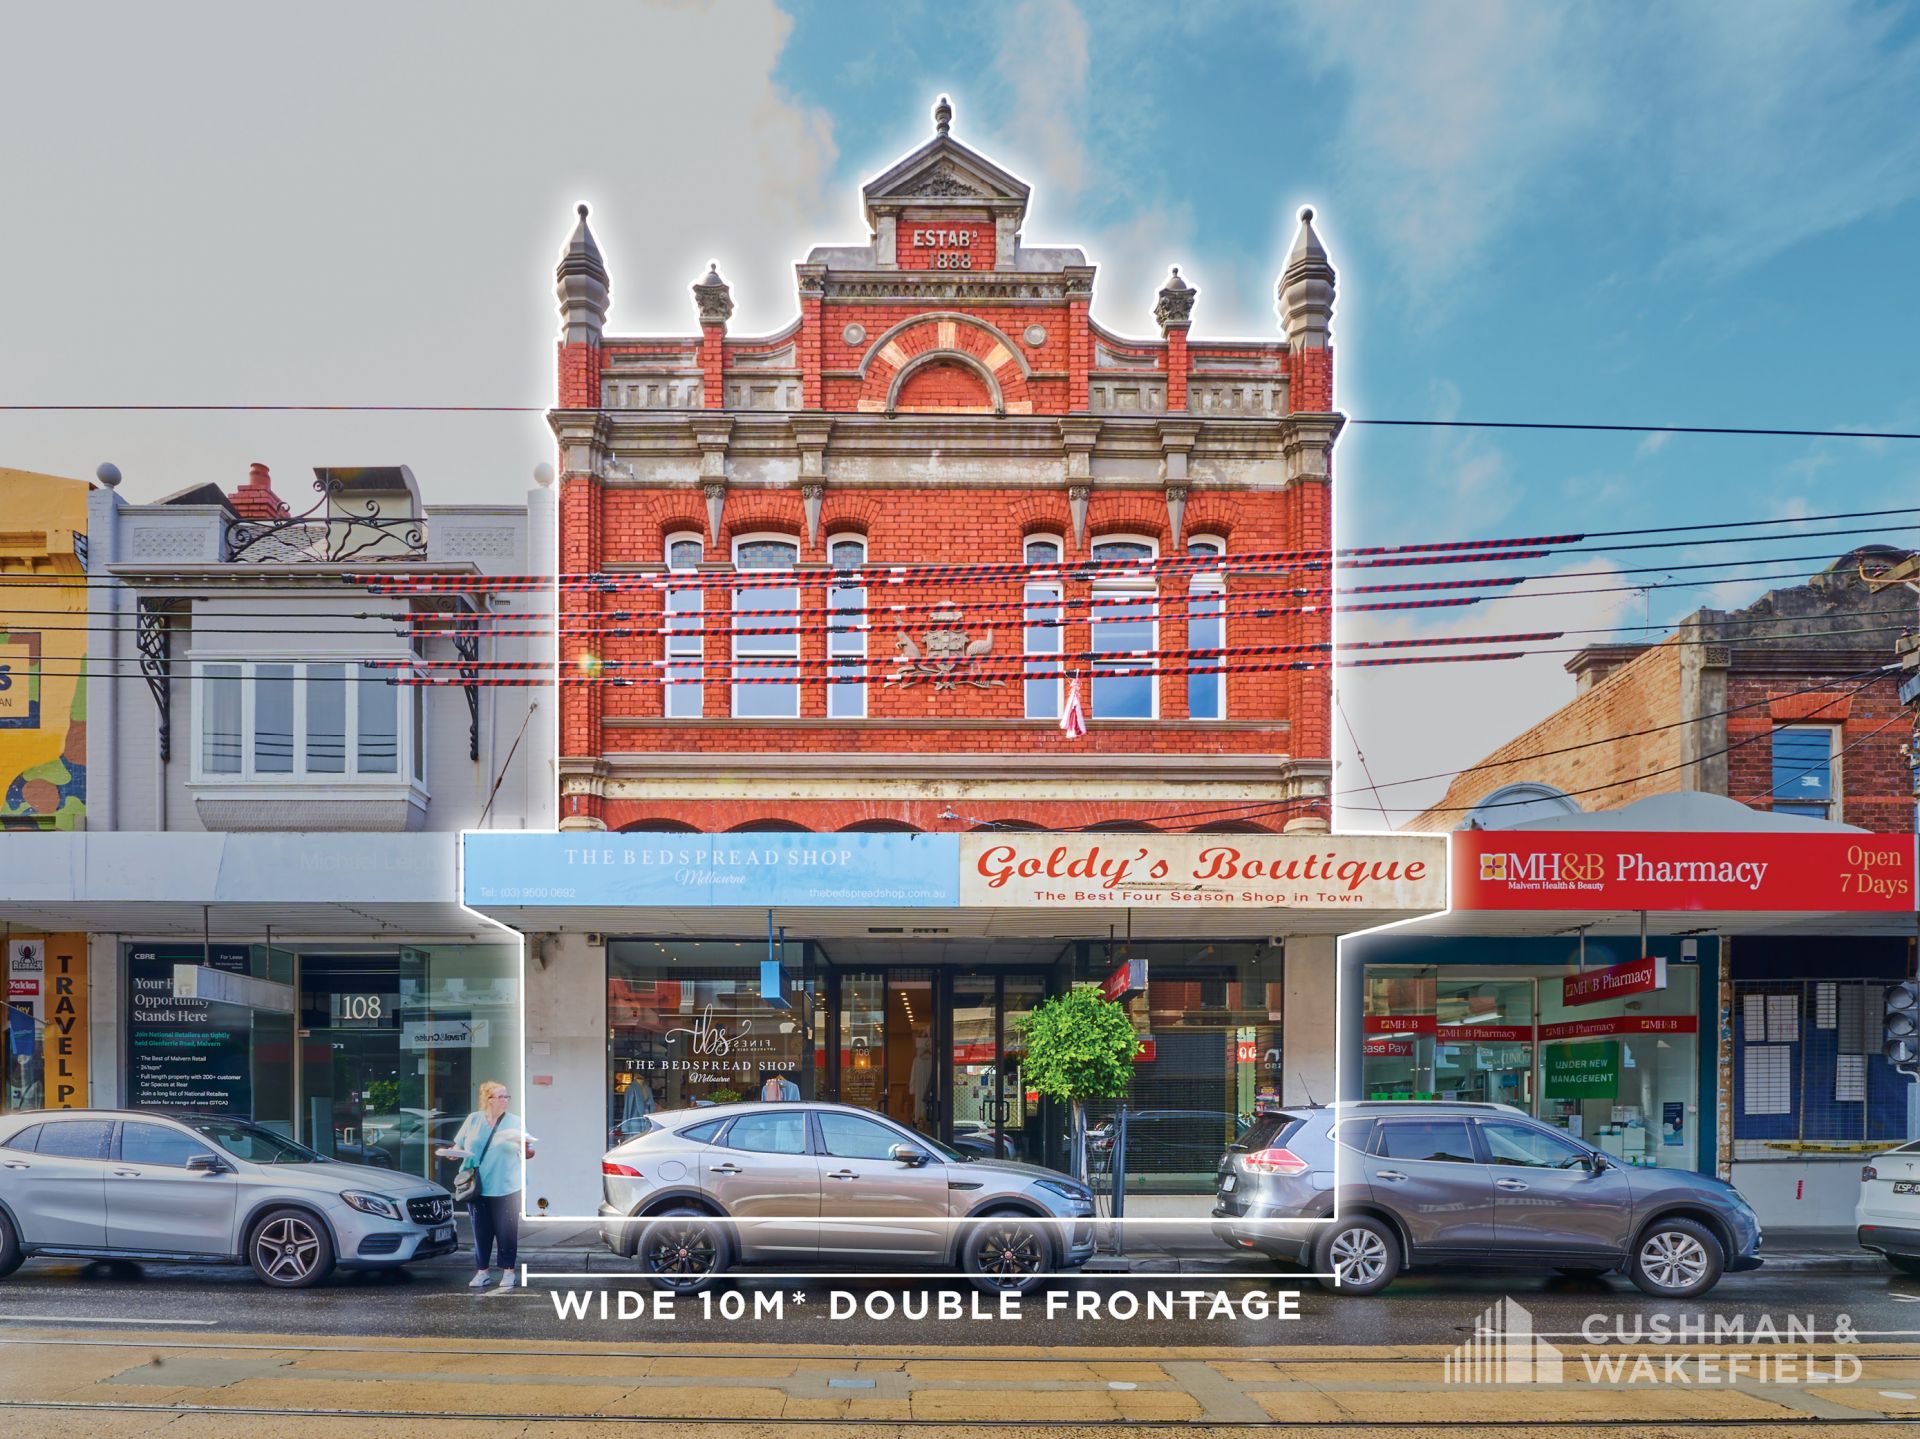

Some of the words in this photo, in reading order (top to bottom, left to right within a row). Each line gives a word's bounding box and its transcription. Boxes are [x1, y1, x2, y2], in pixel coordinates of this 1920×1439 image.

[929, 252, 972, 269] 1888
[564, 849, 615, 865] THE
[623, 849, 780, 866] BEDSPREAD
[787, 849, 852, 866] SHOP
[1847, 845, 1902, 870] Open
[977, 845, 1169, 889] Goldy's
[1192, 846, 1427, 891] Boutique
[1508, 853, 1605, 881] MH&B
[1616, 852, 1768, 890] Pharmacy
[674, 868, 747, 886] Melbourne
[1508, 881, 1541, 890] Malvern
[1542, 881, 1567, 890] Health
[1568, 881, 1576, 890] &
[1577, 881, 1604, 891] Beauty
[1839, 873, 1852, 893] 7
[1857, 873, 1909, 899] Days
[480, 887, 497, 898] Tel:
[500, 887, 520, 899] (03)
[522, 887, 548, 898] 9500
[550, 887, 576, 898] 0692
[809, 888, 946, 900] thebedspreadshop.com.au
[1034, 891, 1067, 901] The
[1074, 891, 1114, 901] Best
[1122, 891, 1162, 902] Four
[1170, 891, 1235, 902] Season
[1241, 891, 1286, 904] Shop
[1293, 892, 1309, 903] in
[1316, 892, 1364, 903] Town
[9, 980, 36, 990] Yakka
[135, 978, 165, 990] Your
[1602, 968, 1653, 990] Pharmacy
[343, 996, 381, 1020] 108
[134, 1010, 176, 1022] Stands
[178, 1010, 208, 1022] Here
[1575, 1022, 1616, 1034] Pharmacy
[1473, 1029, 1517, 1040] Pharmacy
[1388, 1043, 1408, 1054] Pay
[626, 1060, 655, 1071] THE
[661, 1060, 752, 1071] BEDSPREAD
[759, 1060, 796, 1071] SHOP
[1555, 1060, 1587, 1069] UNDER
[1588, 1059, 1608, 1068] NEW
[689, 1071, 731, 1083] Melbourne
[1551, 1073, 1614, 1083] MANAGEMENT
